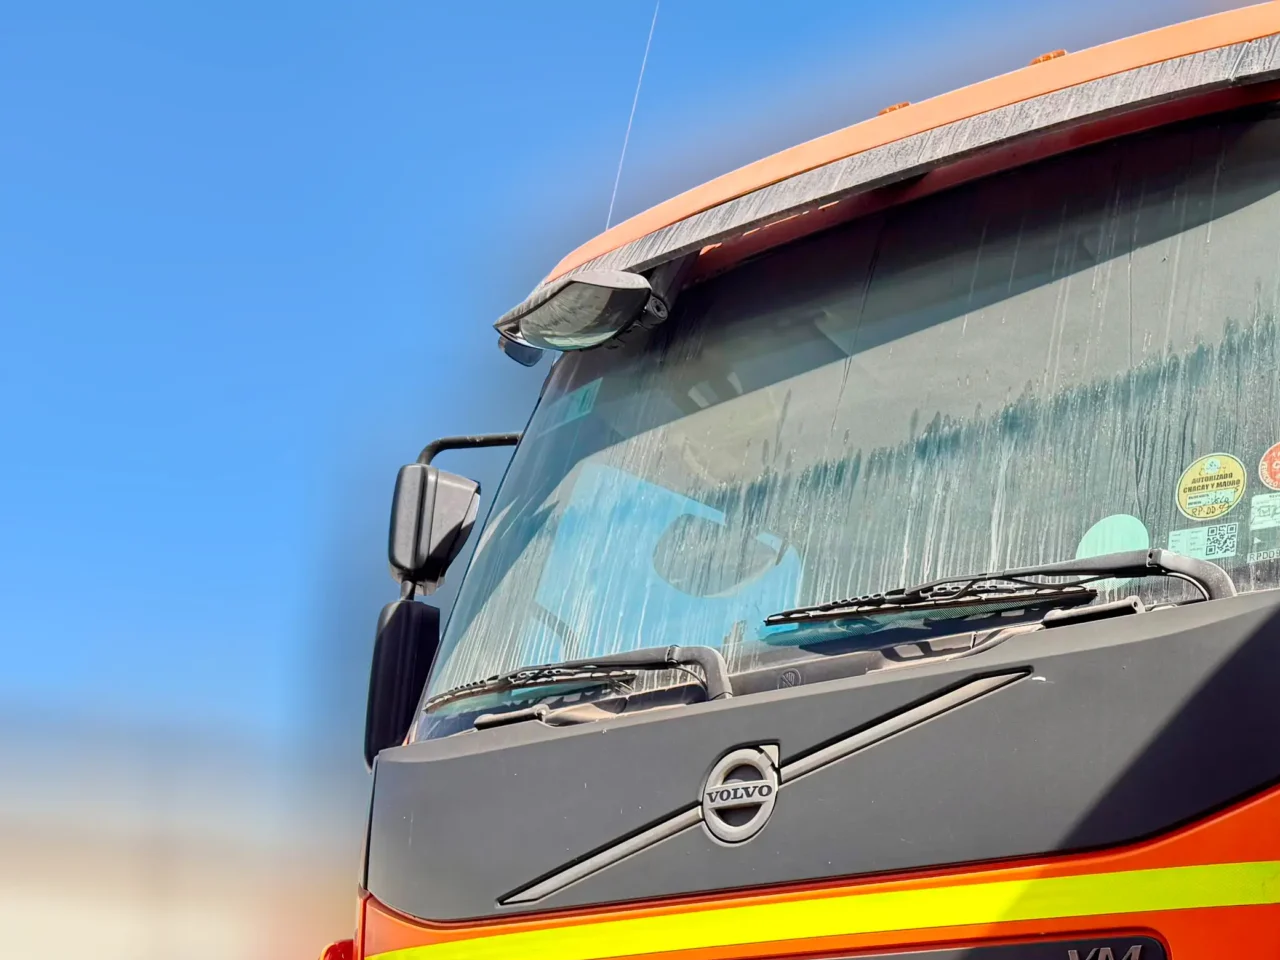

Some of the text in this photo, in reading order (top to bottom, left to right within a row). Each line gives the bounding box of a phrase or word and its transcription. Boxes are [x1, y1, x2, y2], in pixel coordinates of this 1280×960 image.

[1191, 472, 1233, 484] AUTORIZADO
[1183, 484, 1210, 493] CHACAY
[706, 784, 773, 804] VOLVO
